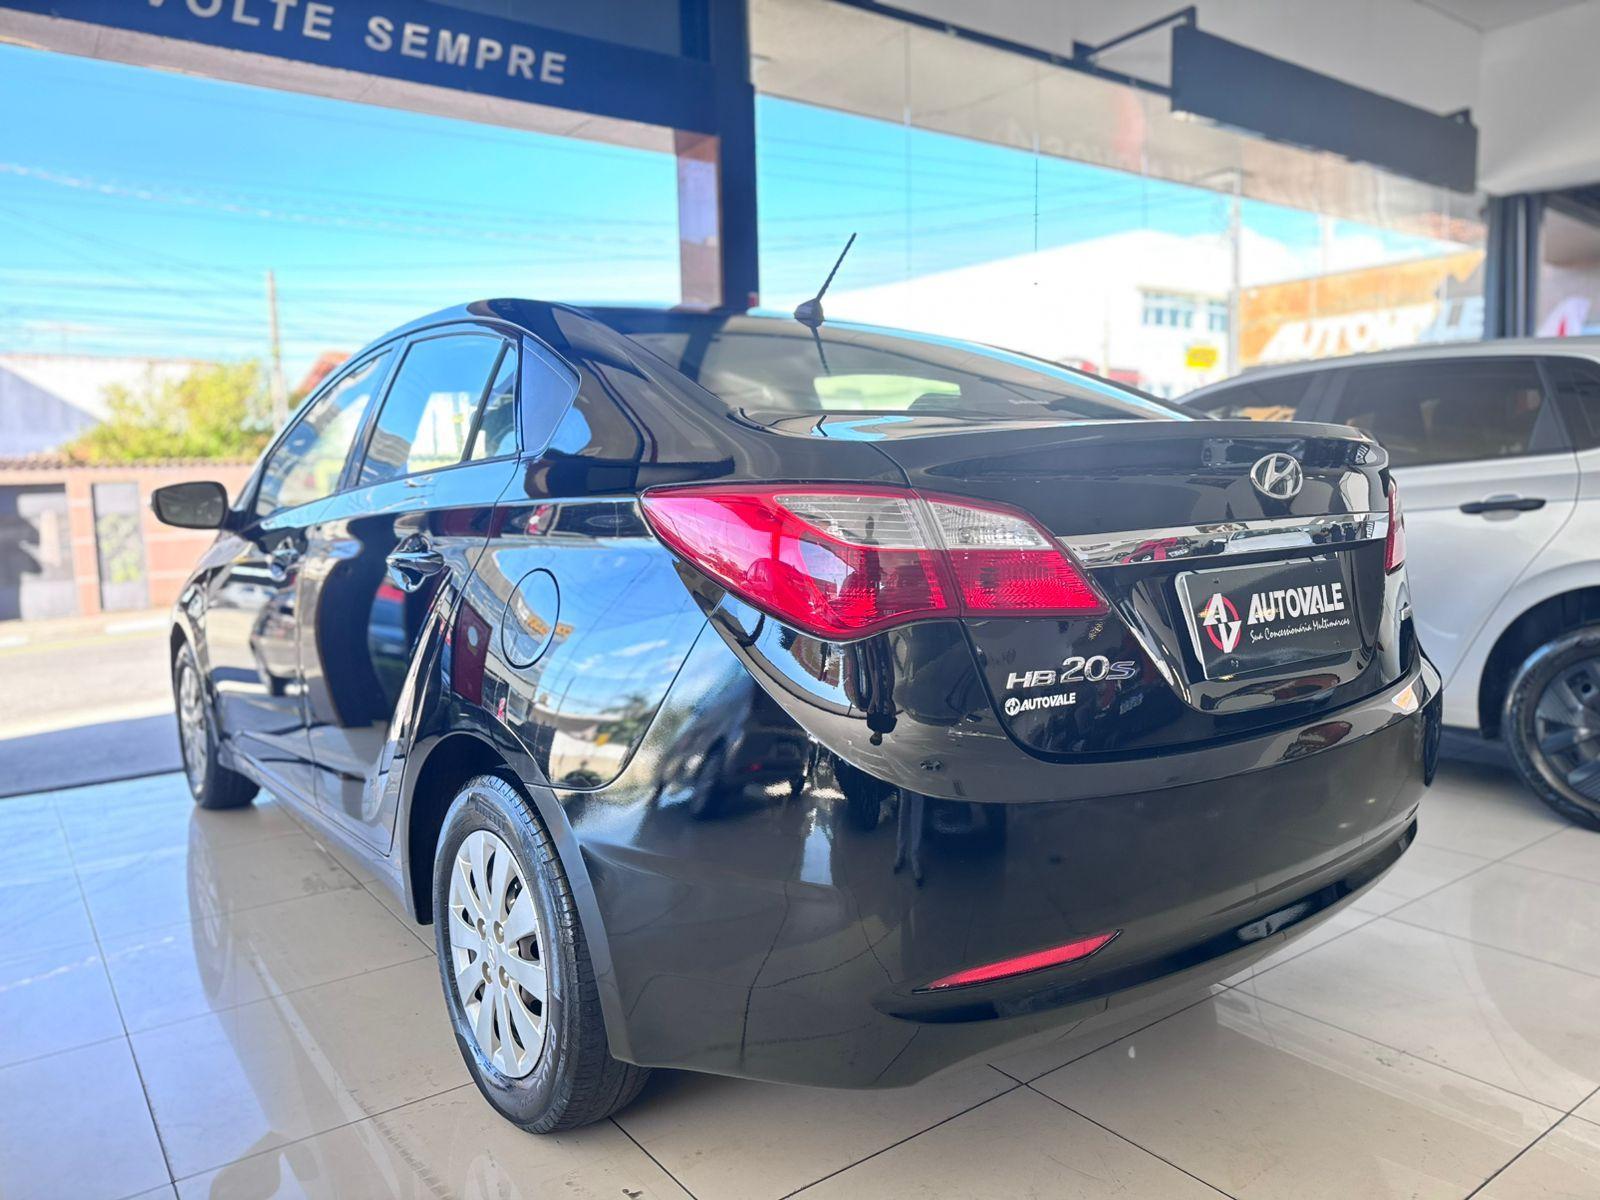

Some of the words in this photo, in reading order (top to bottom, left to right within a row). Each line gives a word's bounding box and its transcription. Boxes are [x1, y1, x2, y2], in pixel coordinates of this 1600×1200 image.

[147, 0, 335, 41] OLTE
[365, 16, 567, 85] SEMPRE
[1247, 582, 1345, 625] AUTOVALE
[1020, 692, 1076, 711] AUTOVALE
